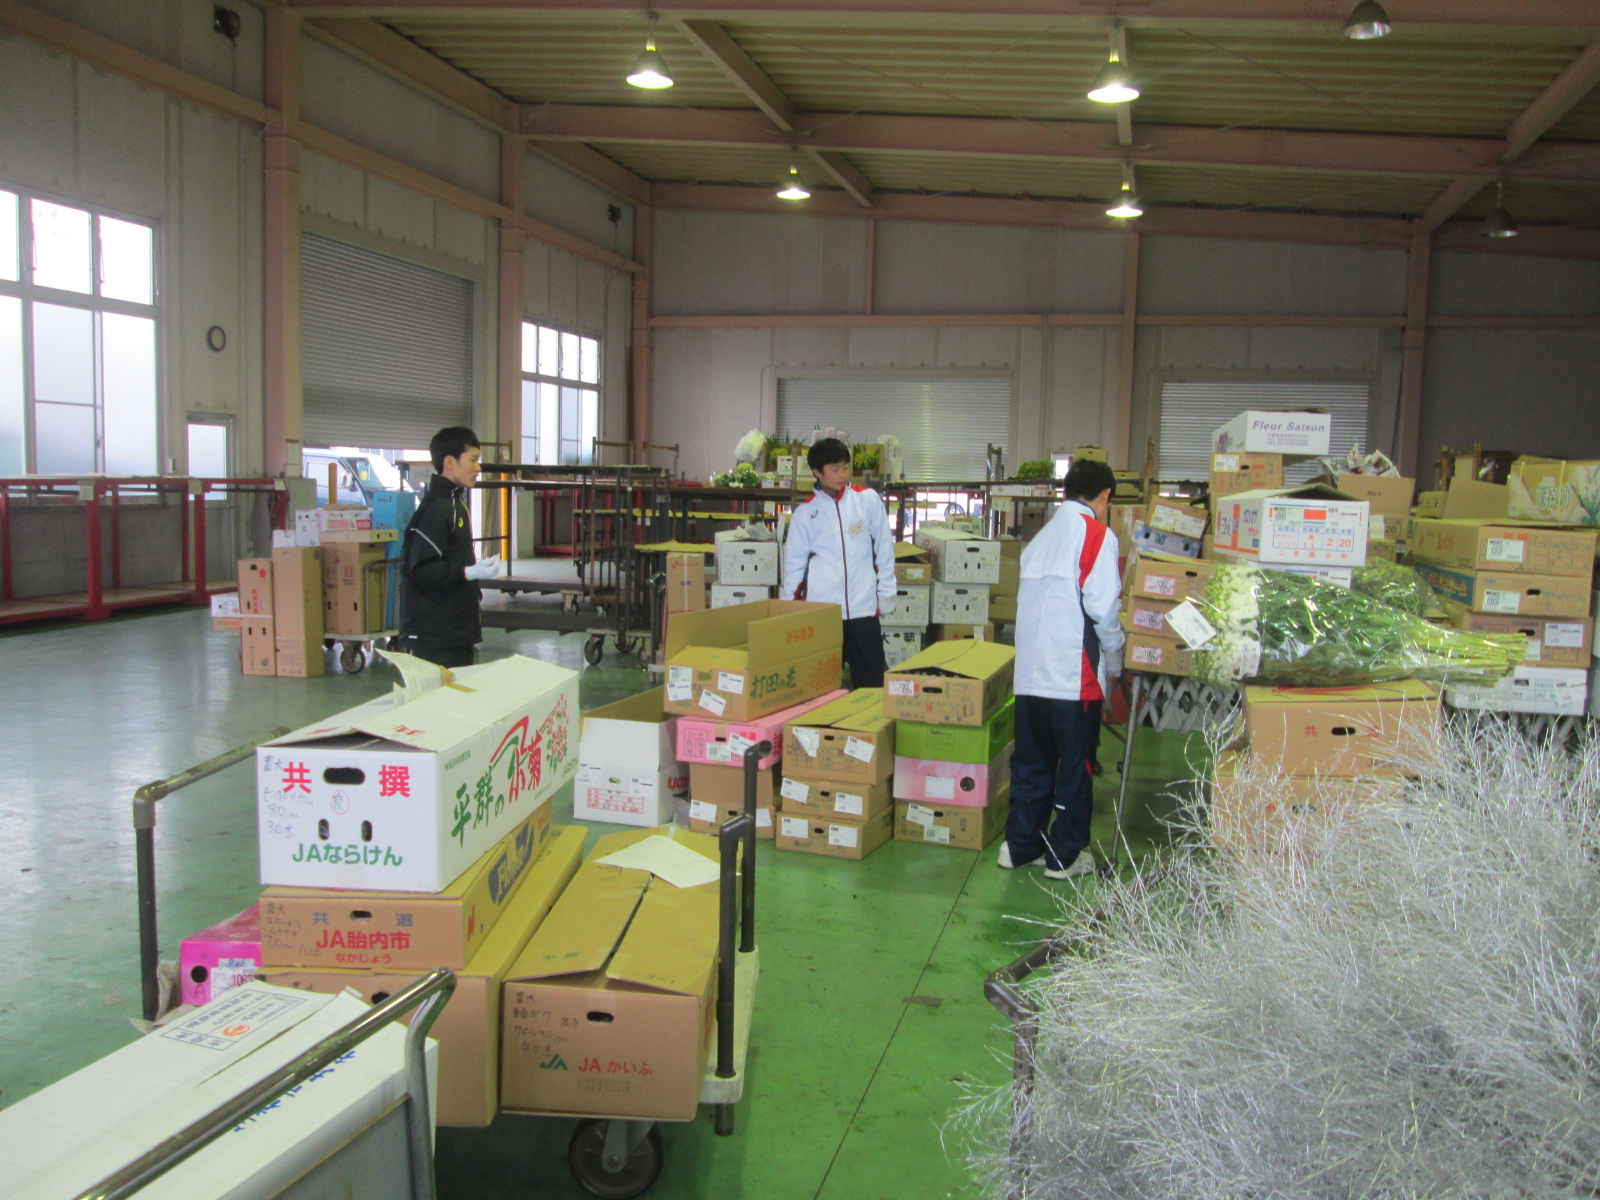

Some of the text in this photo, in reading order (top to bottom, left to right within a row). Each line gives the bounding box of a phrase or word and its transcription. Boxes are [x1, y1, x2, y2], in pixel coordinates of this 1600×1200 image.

[1252, 420, 1325, 432] Fleur Saison
[1326, 538, 1352, 548] 2 20
[750, 666, 797, 700] 打田の花
[1304, 724, 1319, 738] 共
[282, 761, 411, 798] 共 撰
[292, 843, 403, 867] JAならけん
[311, 911, 414, 928] 共 選
[316, 930, 412, 951] JA胎内市
[335, 952, 393, 965] なかじょう
